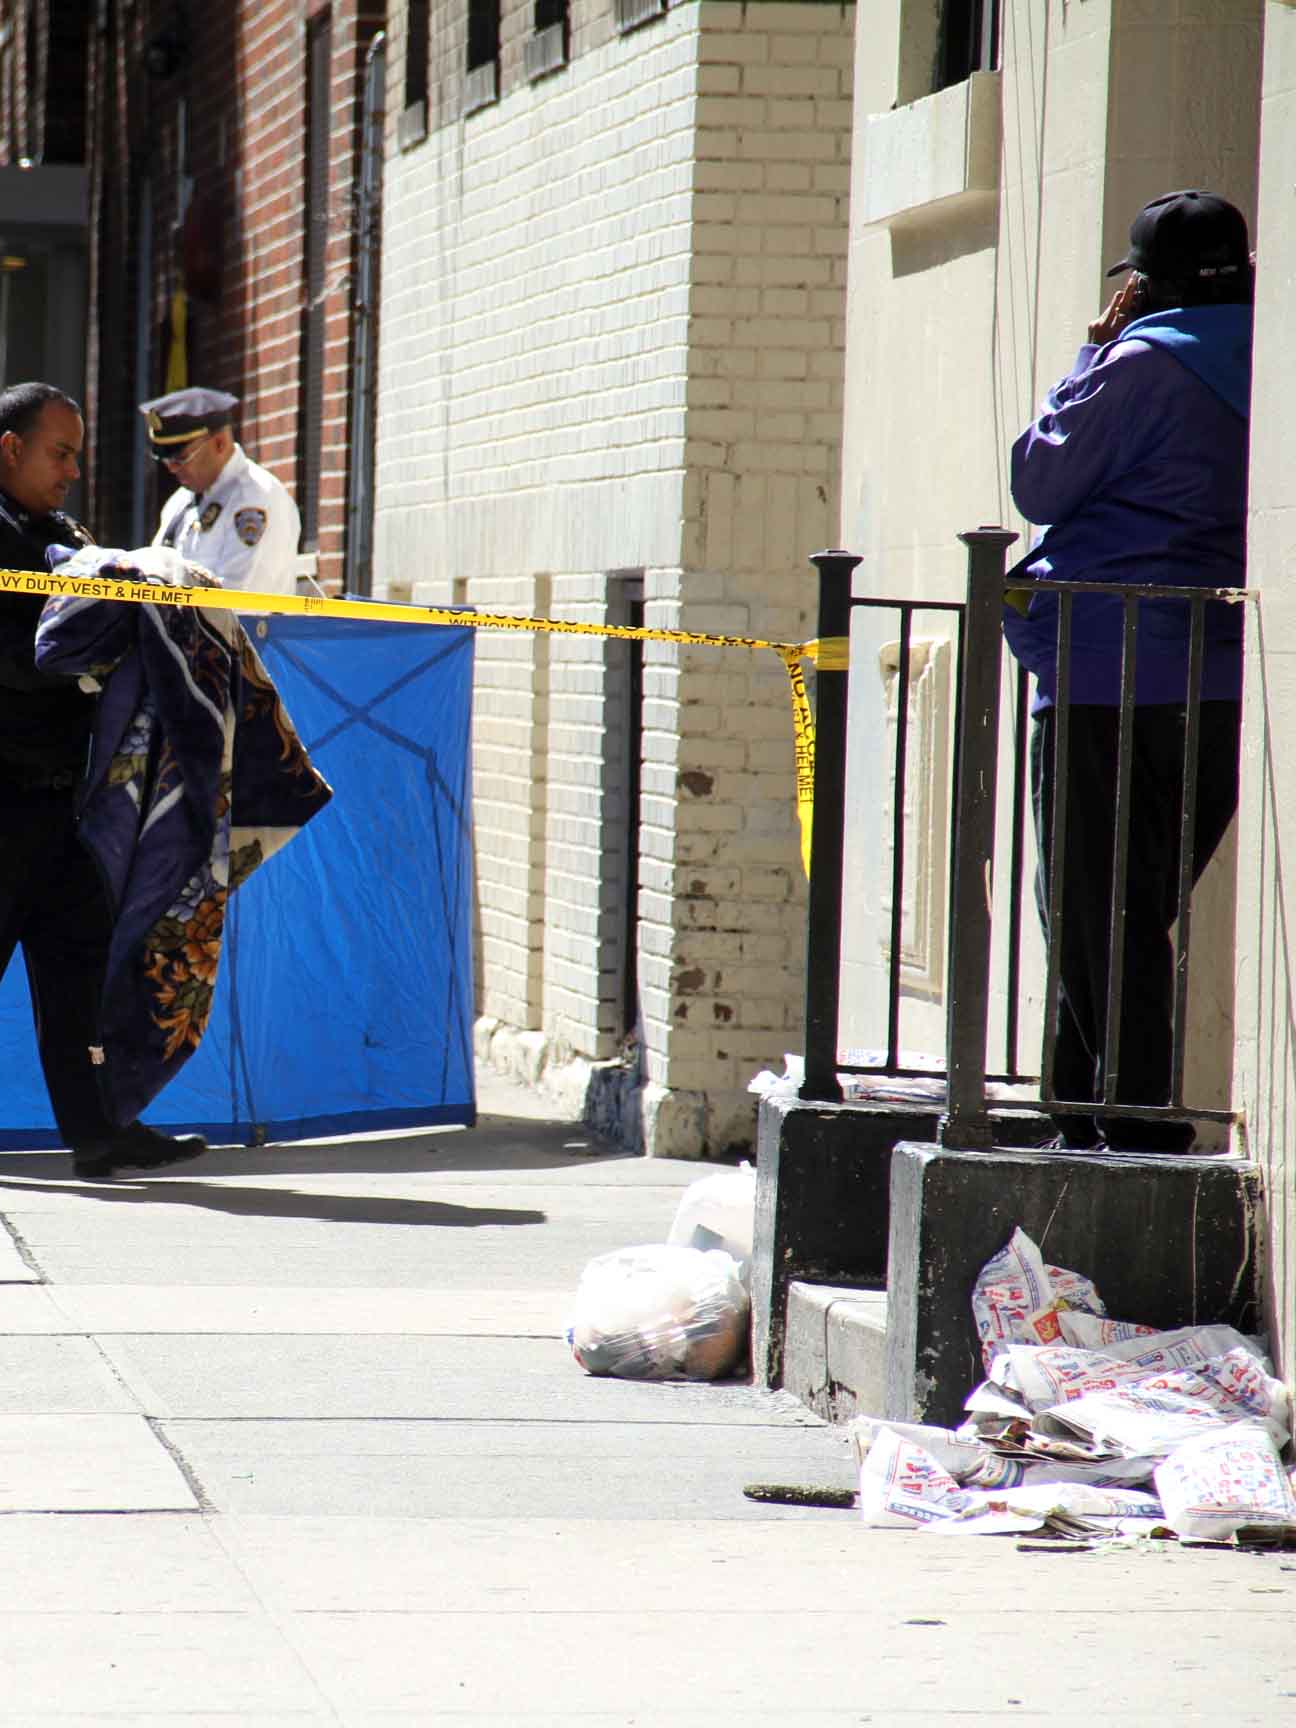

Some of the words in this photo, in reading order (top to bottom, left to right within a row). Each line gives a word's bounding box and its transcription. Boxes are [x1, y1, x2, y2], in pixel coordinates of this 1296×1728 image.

[26, 577, 68, 593] DUTY
[71, 582, 112, 597] VEST
[115, 587, 126, 598] &
[130, 588, 193, 604] HELMET
[796, 745, 814, 804] HELMET
